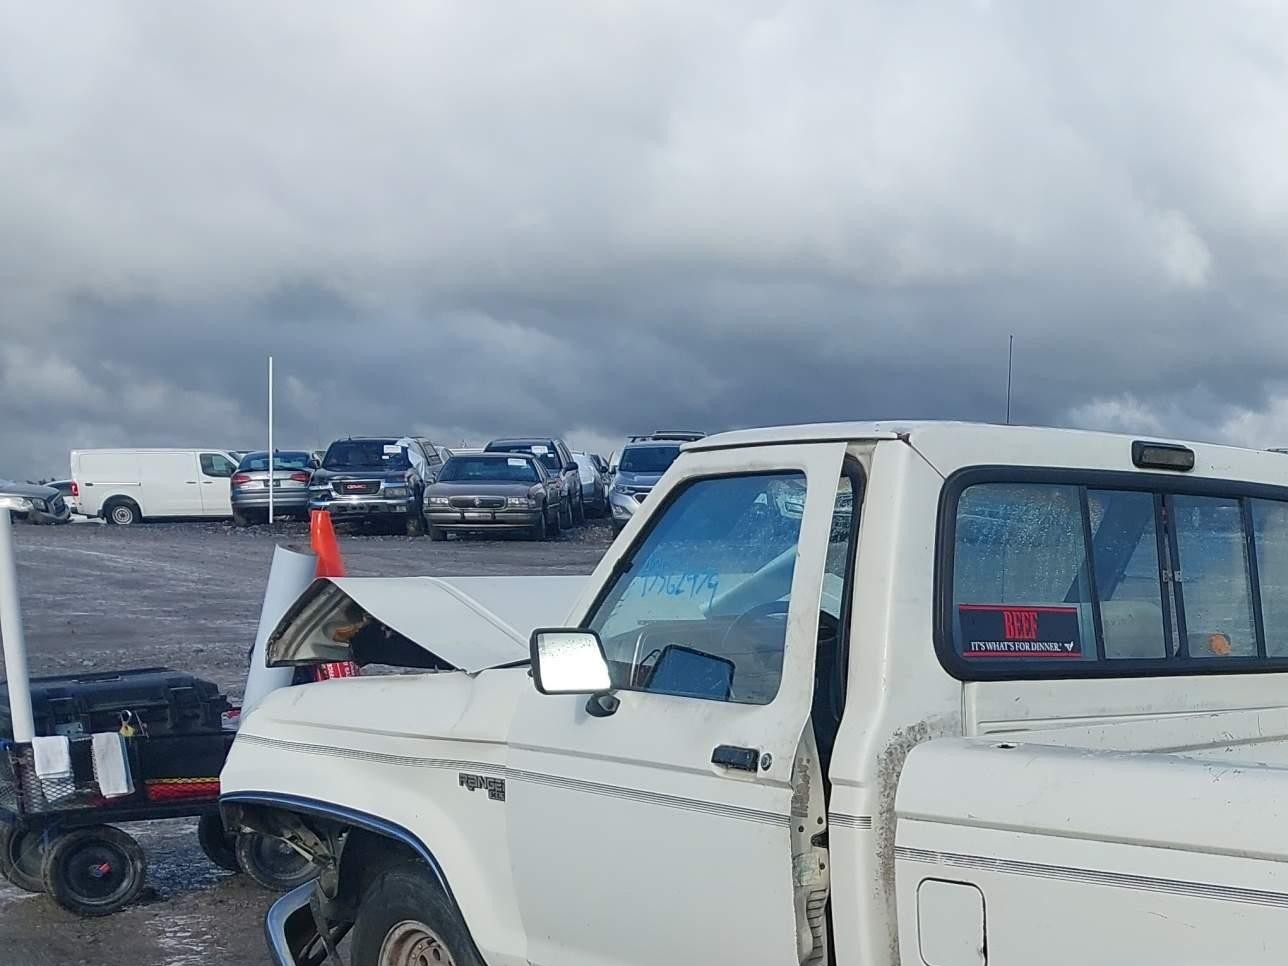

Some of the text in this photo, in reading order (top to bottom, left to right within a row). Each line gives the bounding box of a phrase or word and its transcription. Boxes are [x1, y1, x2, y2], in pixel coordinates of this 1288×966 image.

[1003, 611, 1038, 639] BEEF
[970, 641, 985, 652] IT'S
[985, 641, 1015, 652] WHAT'S
[1015, 642, 1031, 652] FOR
